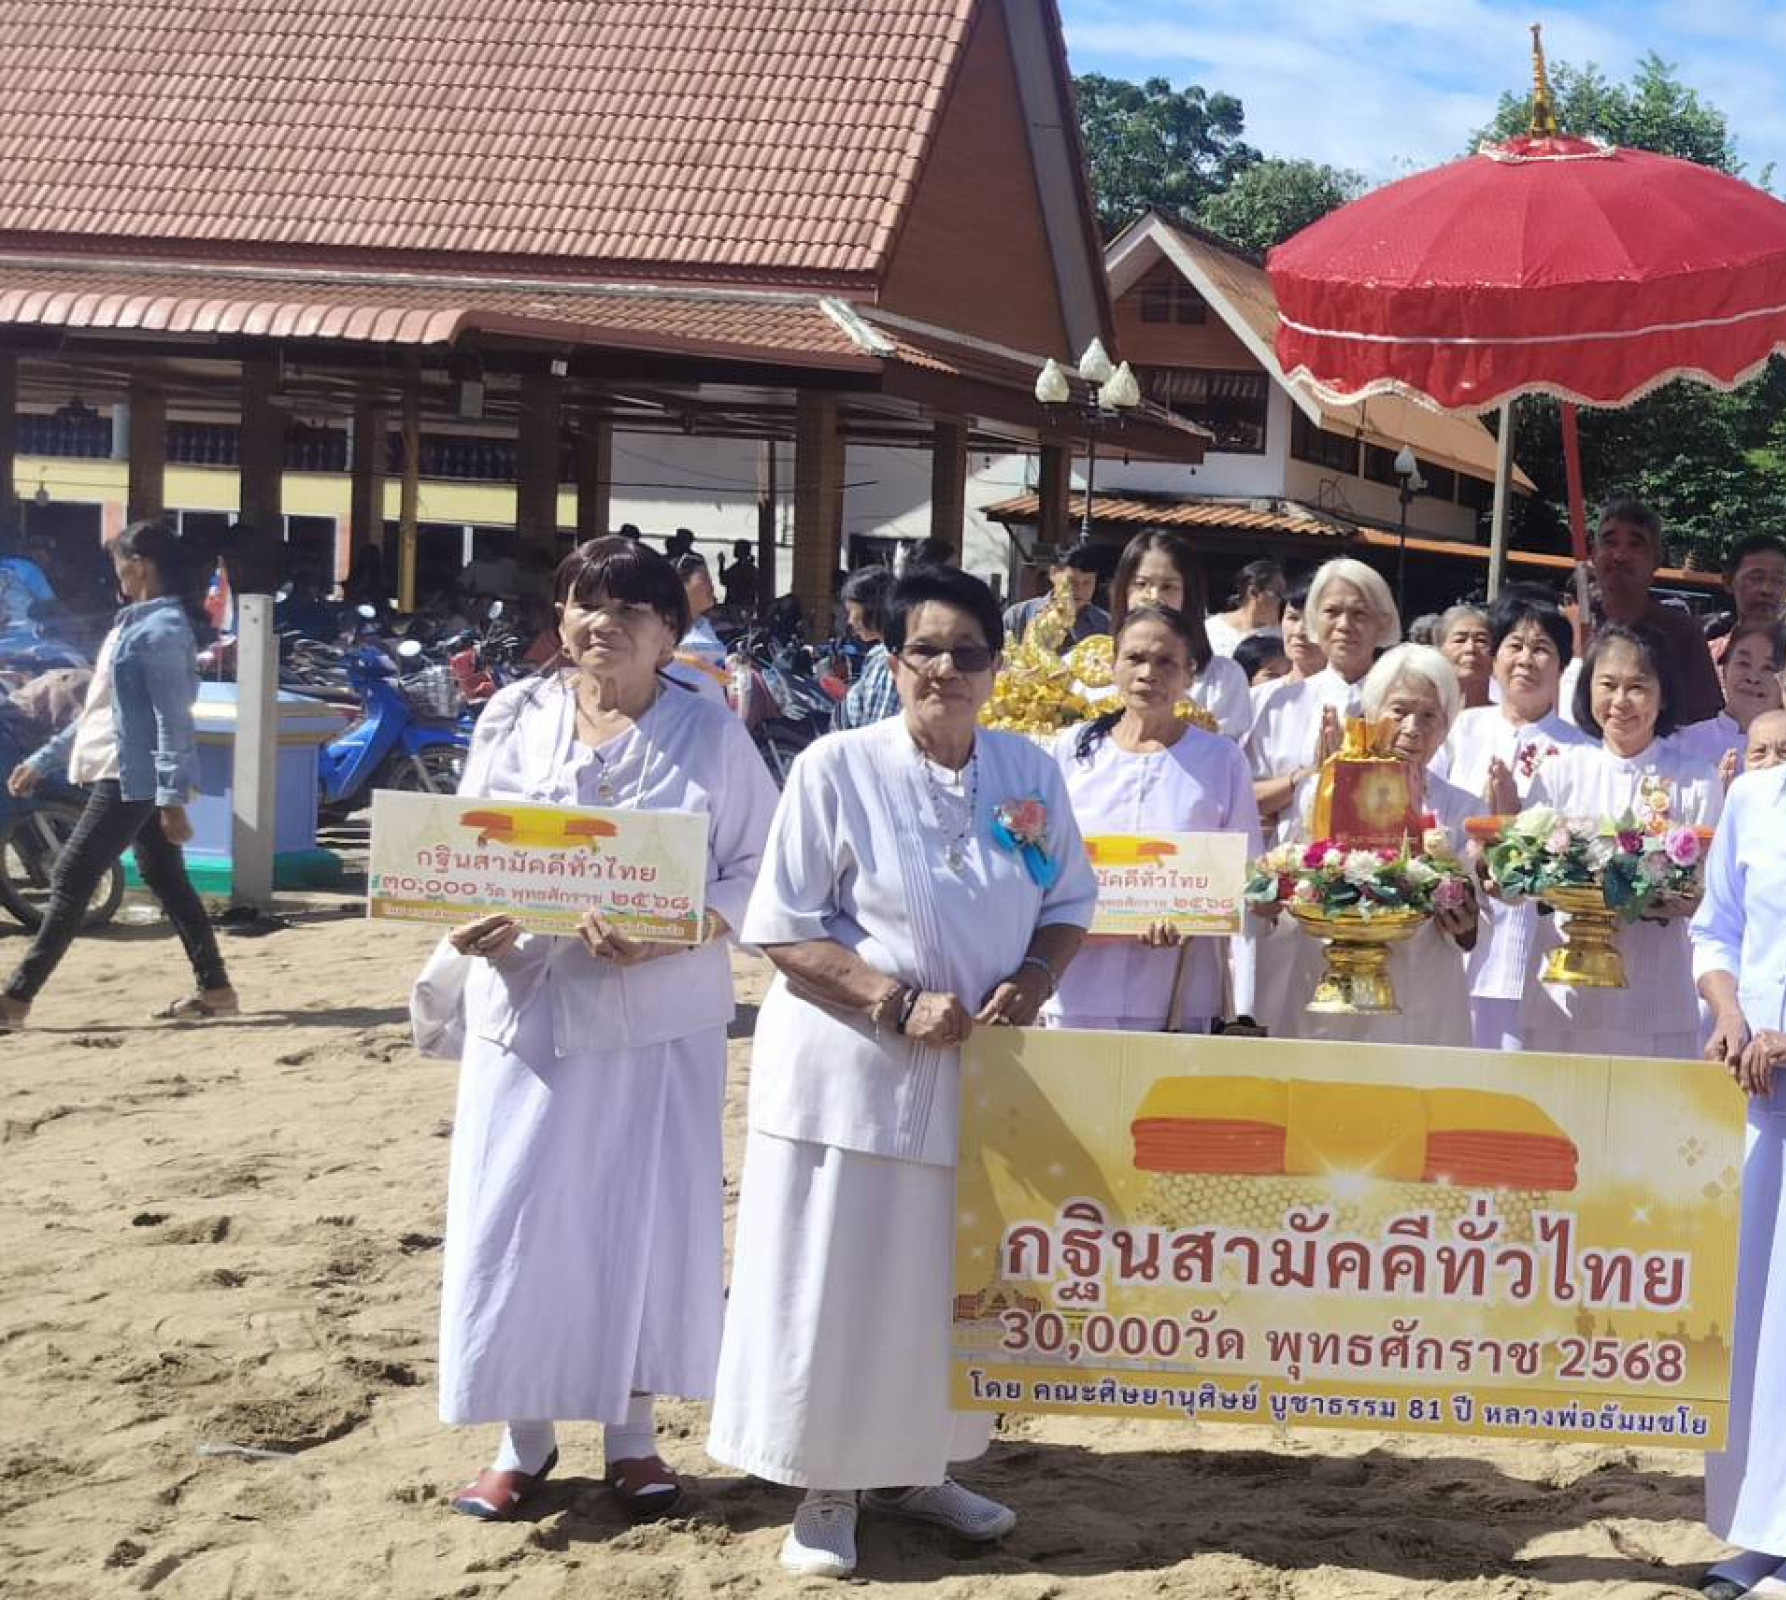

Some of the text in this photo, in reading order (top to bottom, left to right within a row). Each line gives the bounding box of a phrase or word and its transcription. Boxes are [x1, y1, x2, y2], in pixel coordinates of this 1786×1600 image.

[1007, 1200, 1685, 1305] กฐินสามัคคีทั่วไทย
[1002, 1310, 1685, 1383] 30,000วัด พุทธศักราช 2568
[970, 1370, 1708, 1435] โดย คณะศิษยานุศิษย์ บูชาธรรม 81 ปี หลวงพ่อธัมมชโย
